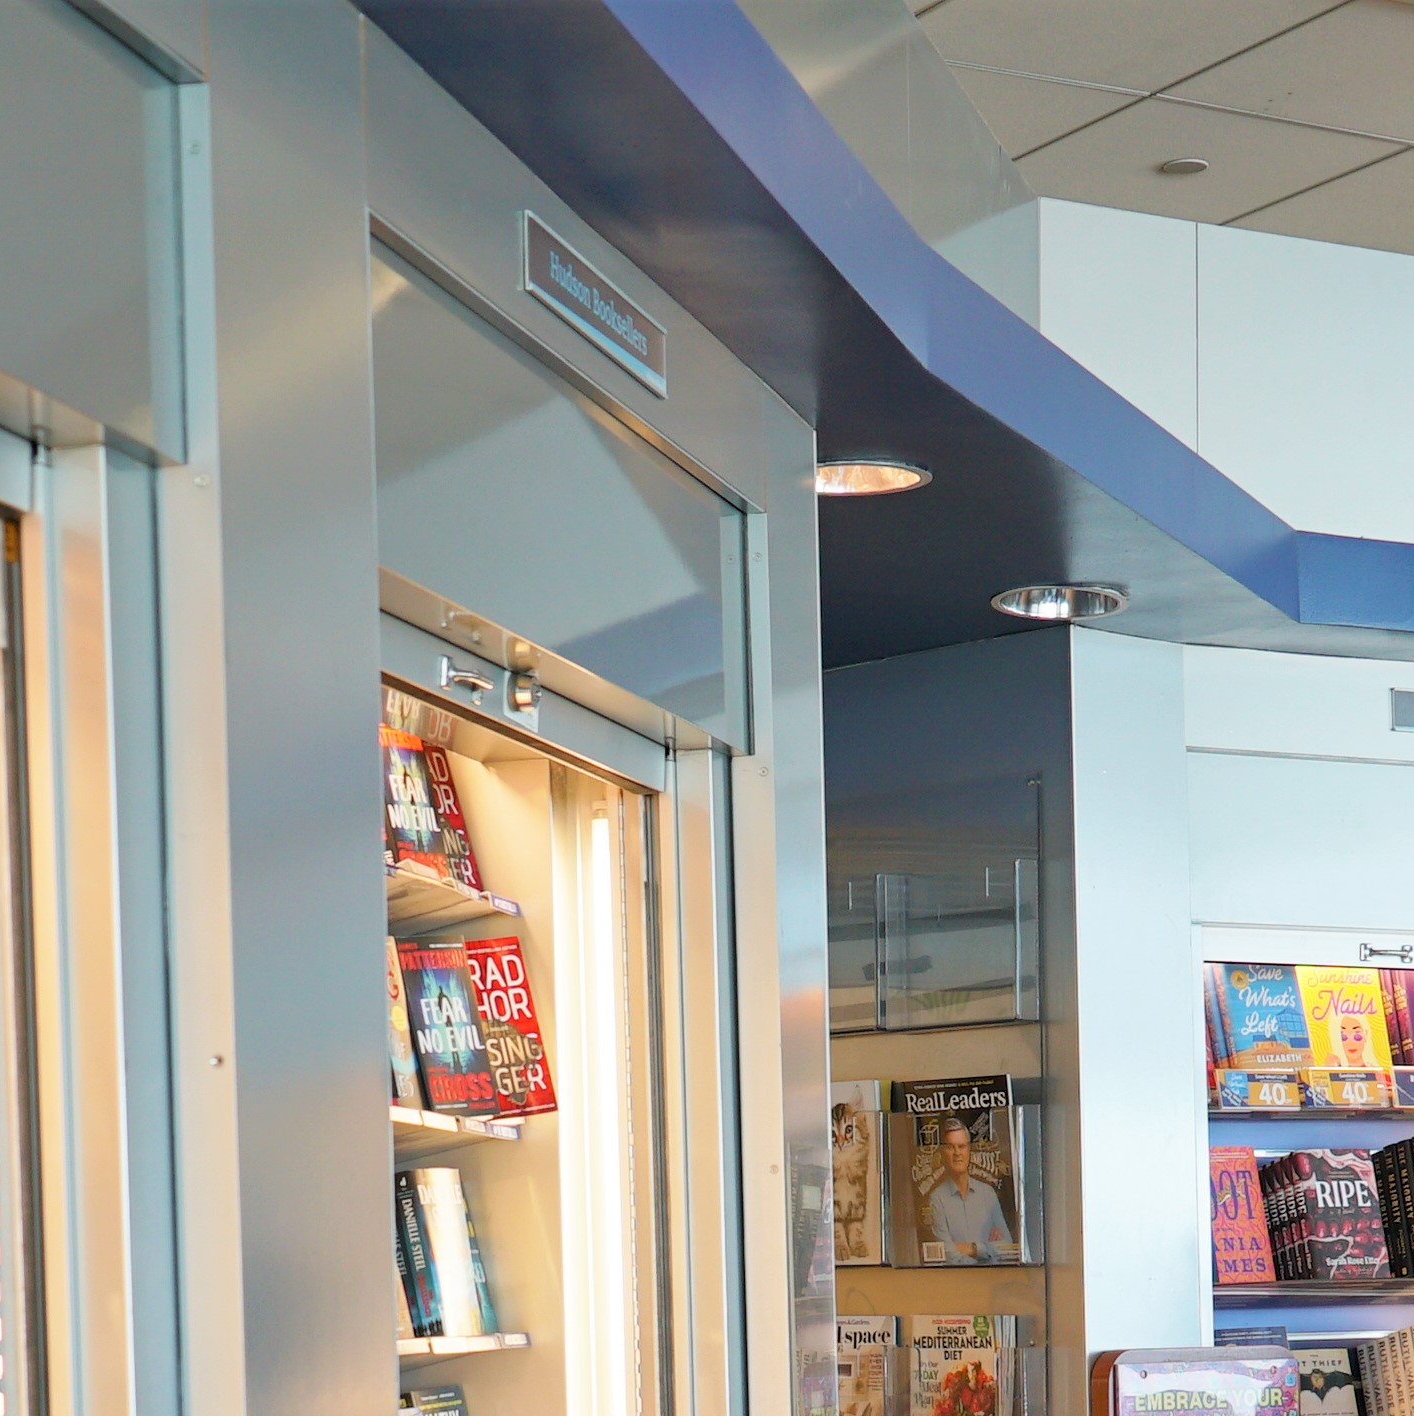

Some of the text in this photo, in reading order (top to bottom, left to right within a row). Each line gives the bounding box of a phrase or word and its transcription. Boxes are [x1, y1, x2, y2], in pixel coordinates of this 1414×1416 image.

[550, 251, 648, 356] Hudson Booksellers
[1248, 965, 1283, 982] Save
[1308, 967, 1373, 987] Sunshine
[1239, 986, 1296, 1008] What's
[1311, 987, 1377, 1021] Nails
[420, 997, 468, 1025] FEAR
[1241, 1011, 1280, 1037] Left
[417, 1025, 485, 1054] NO EVIL
[486, 1033, 543, 1066] SING
[1256, 1055, 1302, 1063] ELIZABETH
[428, 1072, 495, 1101] CROSS
[495, 1065, 547, 1095] GER
[906, 1087, 1007, 1112] RealLeaders
[1259, 1083, 1286, 1105] 40
[1342, 1082, 1367, 1104] 40
[1314, 1180, 1372, 1208] RIPE
[913, 1336, 992, 1349] MEDITERRANEAN
[937, 1326, 967, 1335] SUMMER
[944, 1350, 963, 1360] DIET
[1311, 1359, 1343, 1368] THIEF
[1134, 1389, 1228, 1413] EMBRACE
